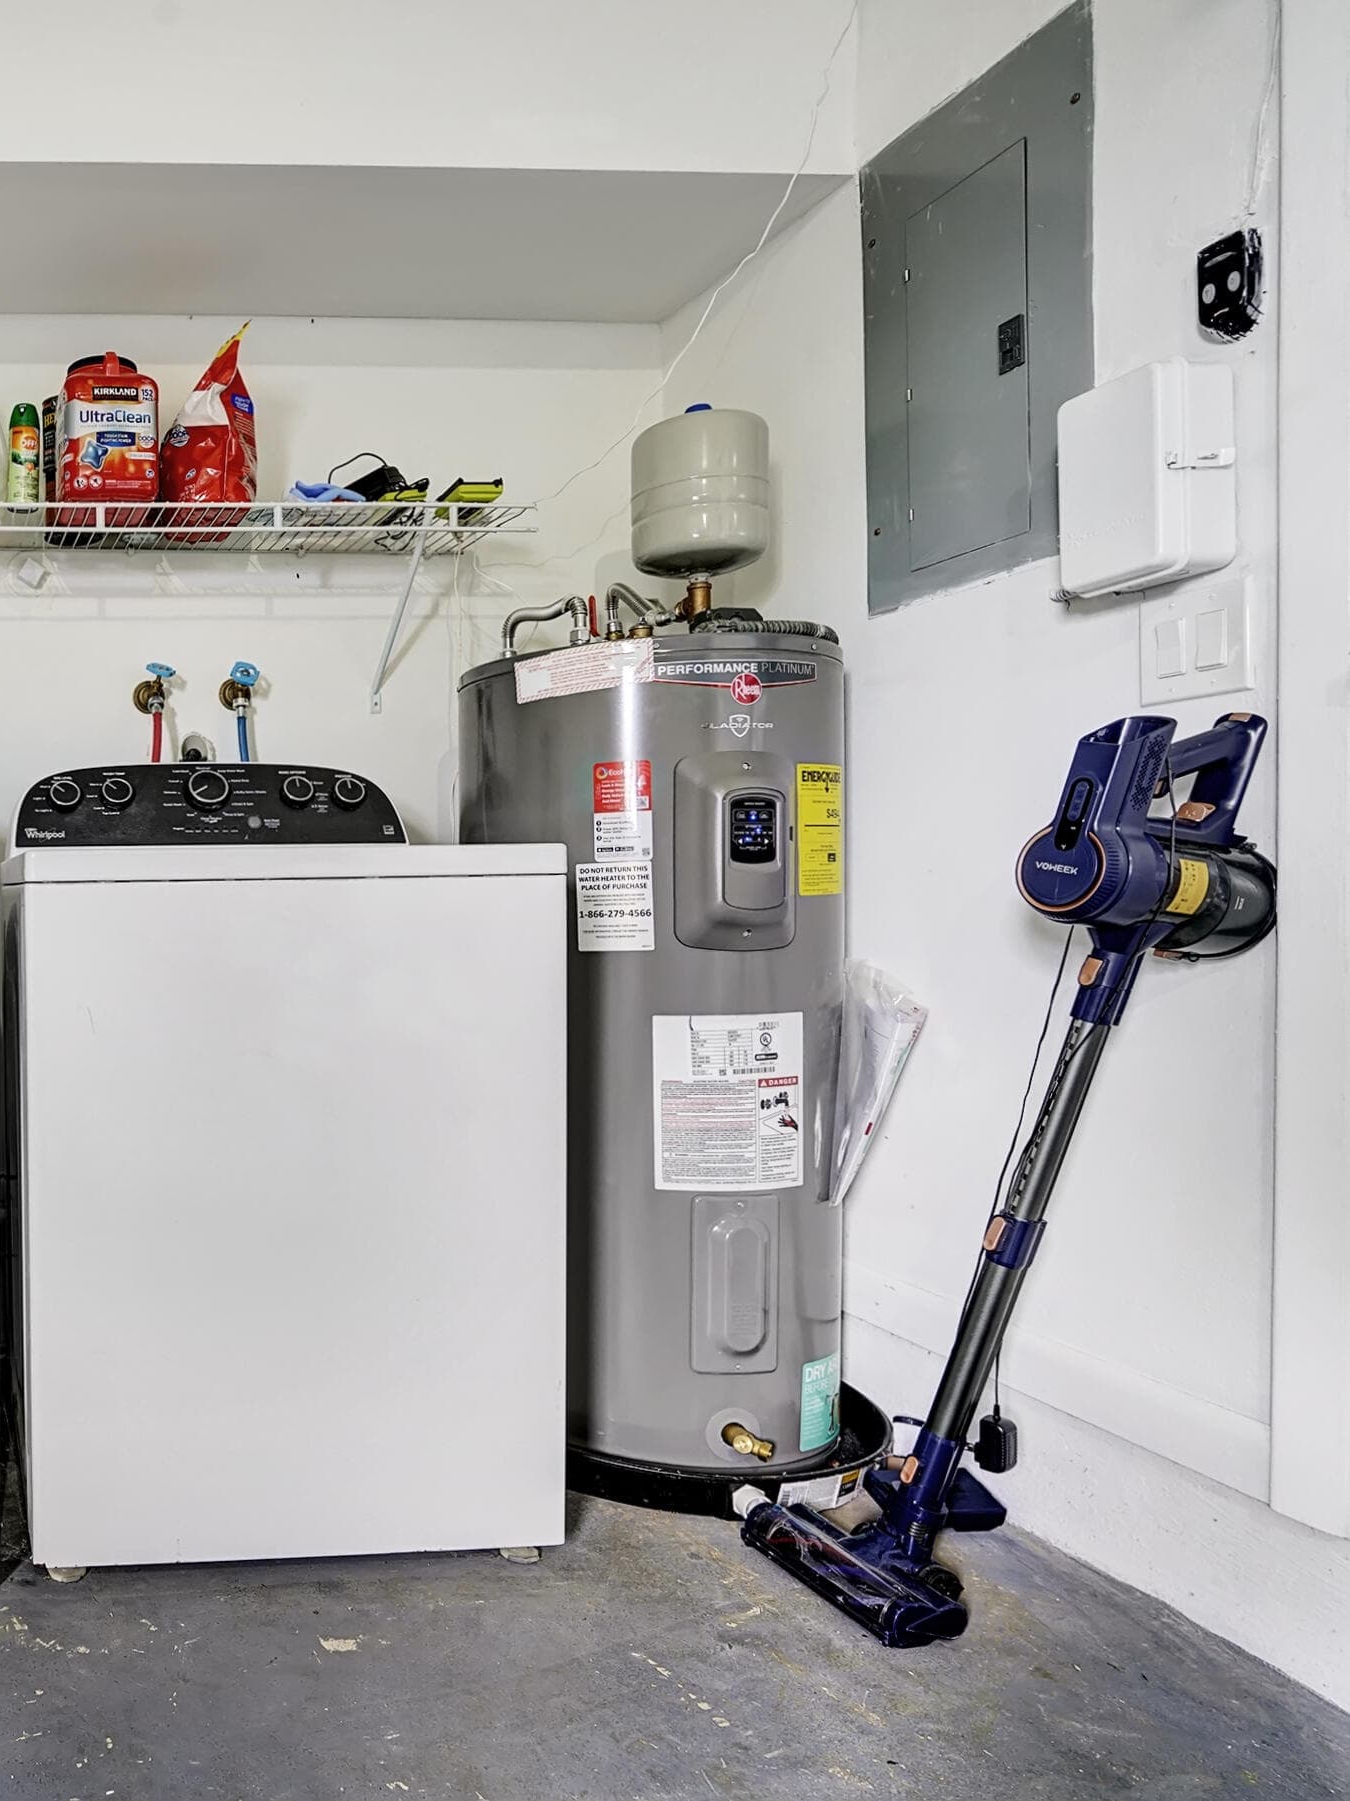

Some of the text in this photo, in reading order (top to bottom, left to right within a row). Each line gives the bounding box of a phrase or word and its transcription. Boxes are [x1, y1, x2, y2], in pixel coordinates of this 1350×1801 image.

[93, 387, 137, 396] KIRKLAND
[79, 410, 151, 424] UltraClean
[657, 662, 813, 676] PERFORMANCE PLATINUM
[735, 673, 761, 700] Rheem
[25, 828, 65, 840] Whirlpool
[612, 882, 647, 890] PURCHASE
[579, 908, 652, 919] 1-866-279-4566
[769, 1077, 797, 1086] DANGER
